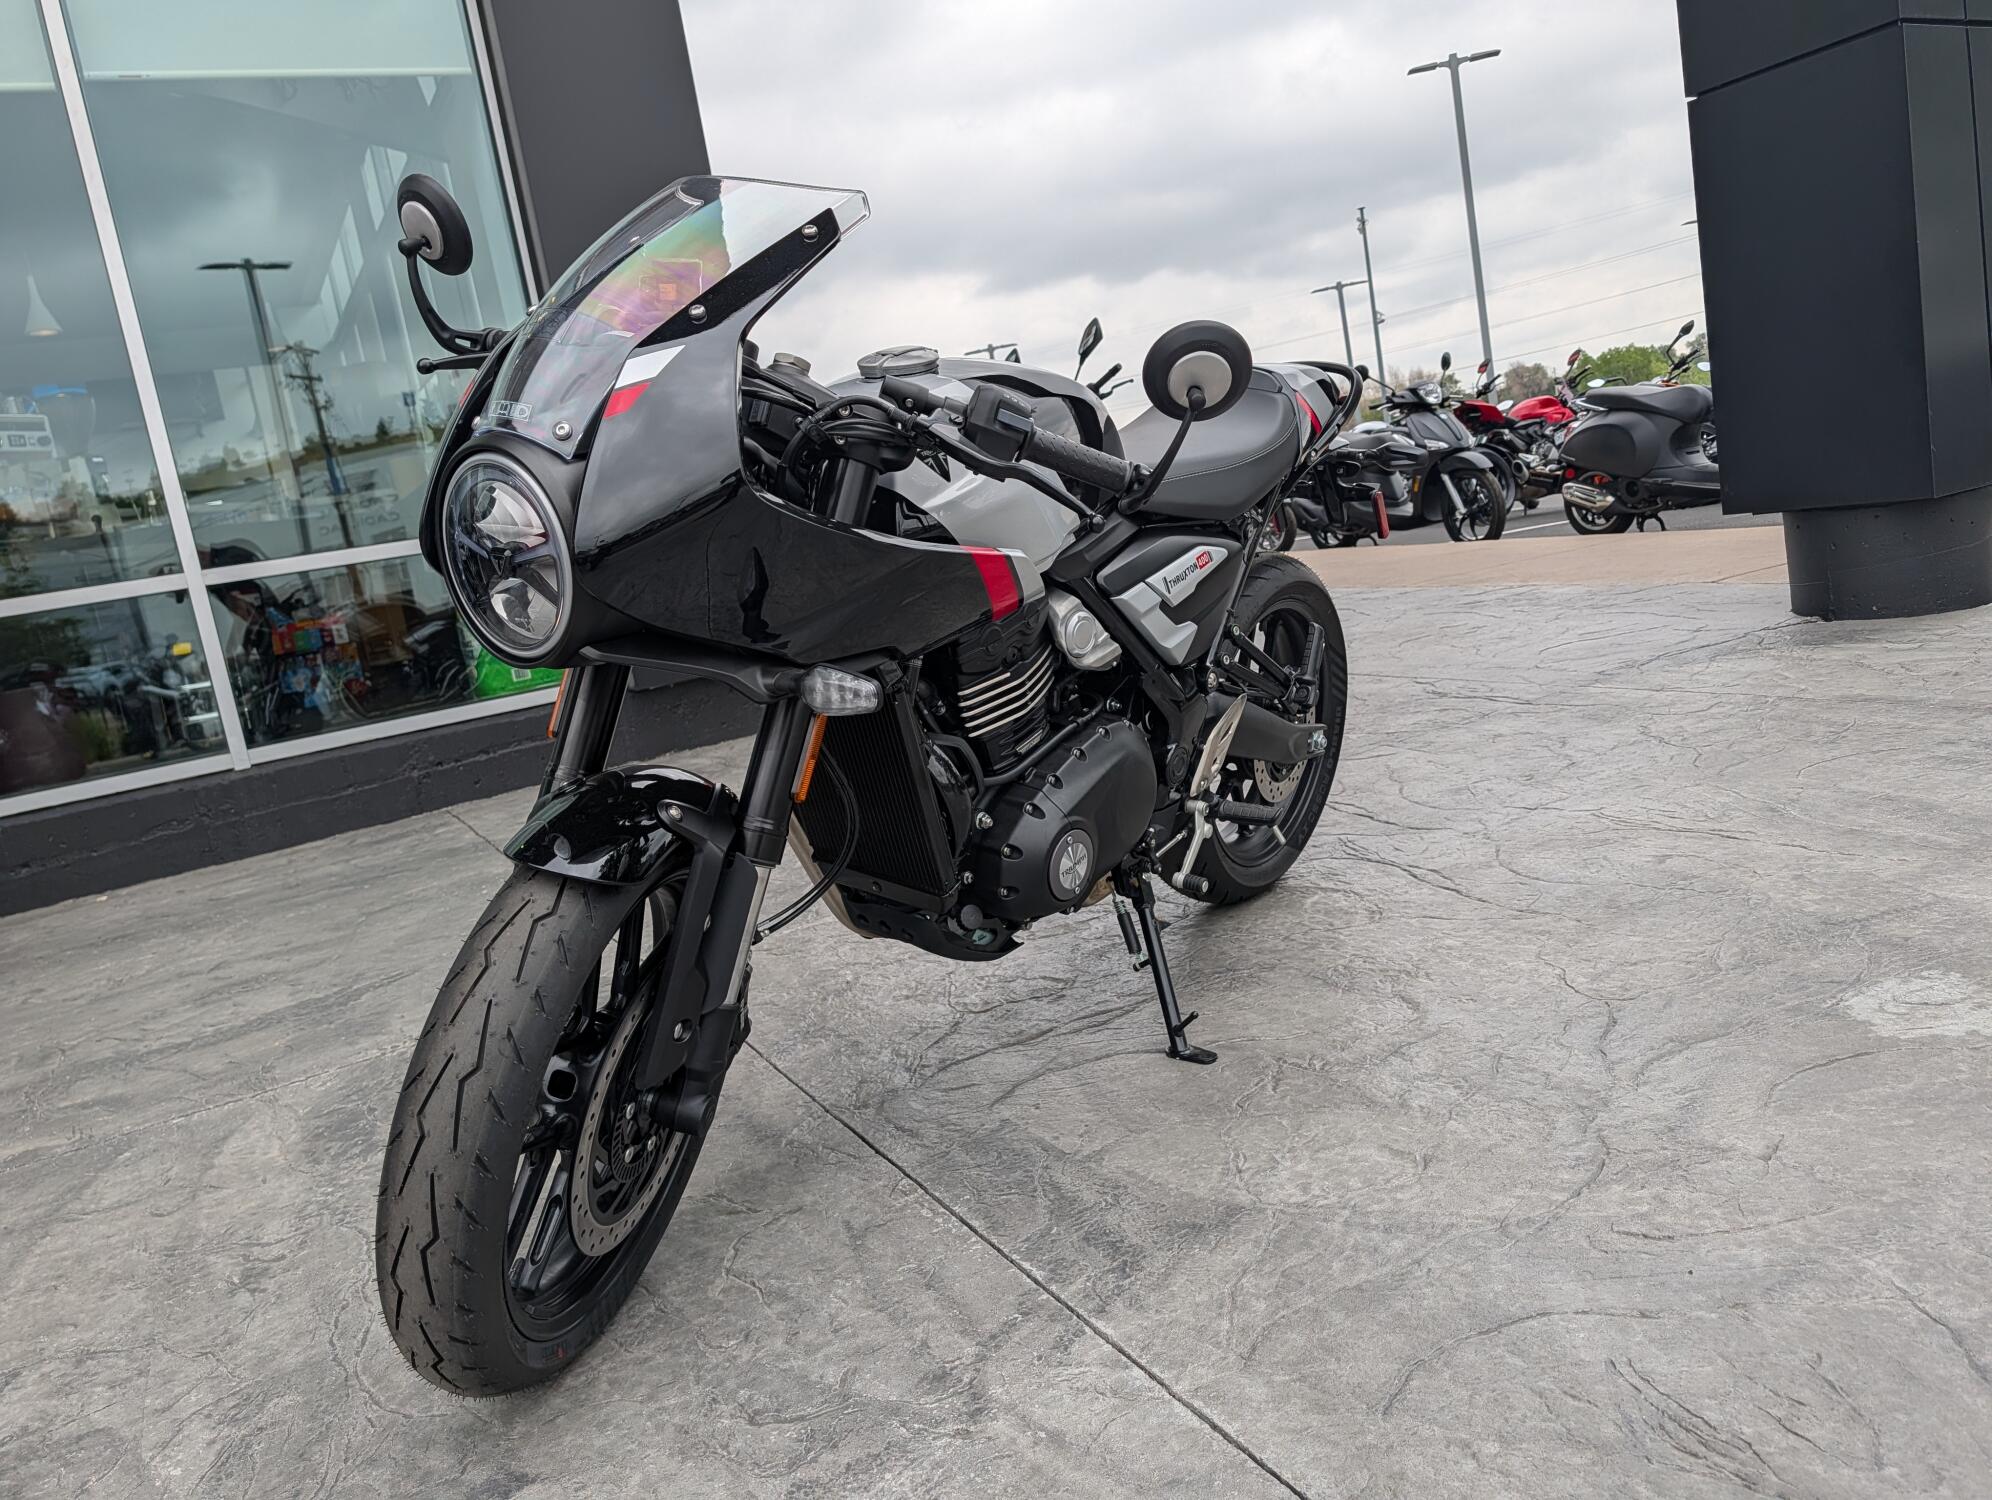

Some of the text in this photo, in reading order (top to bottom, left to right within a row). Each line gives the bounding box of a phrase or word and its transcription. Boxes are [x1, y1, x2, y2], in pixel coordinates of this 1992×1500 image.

[1168, 553, 1210, 589] THRUXTON 400
[1061, 854, 1087, 878] TRIUMPH
